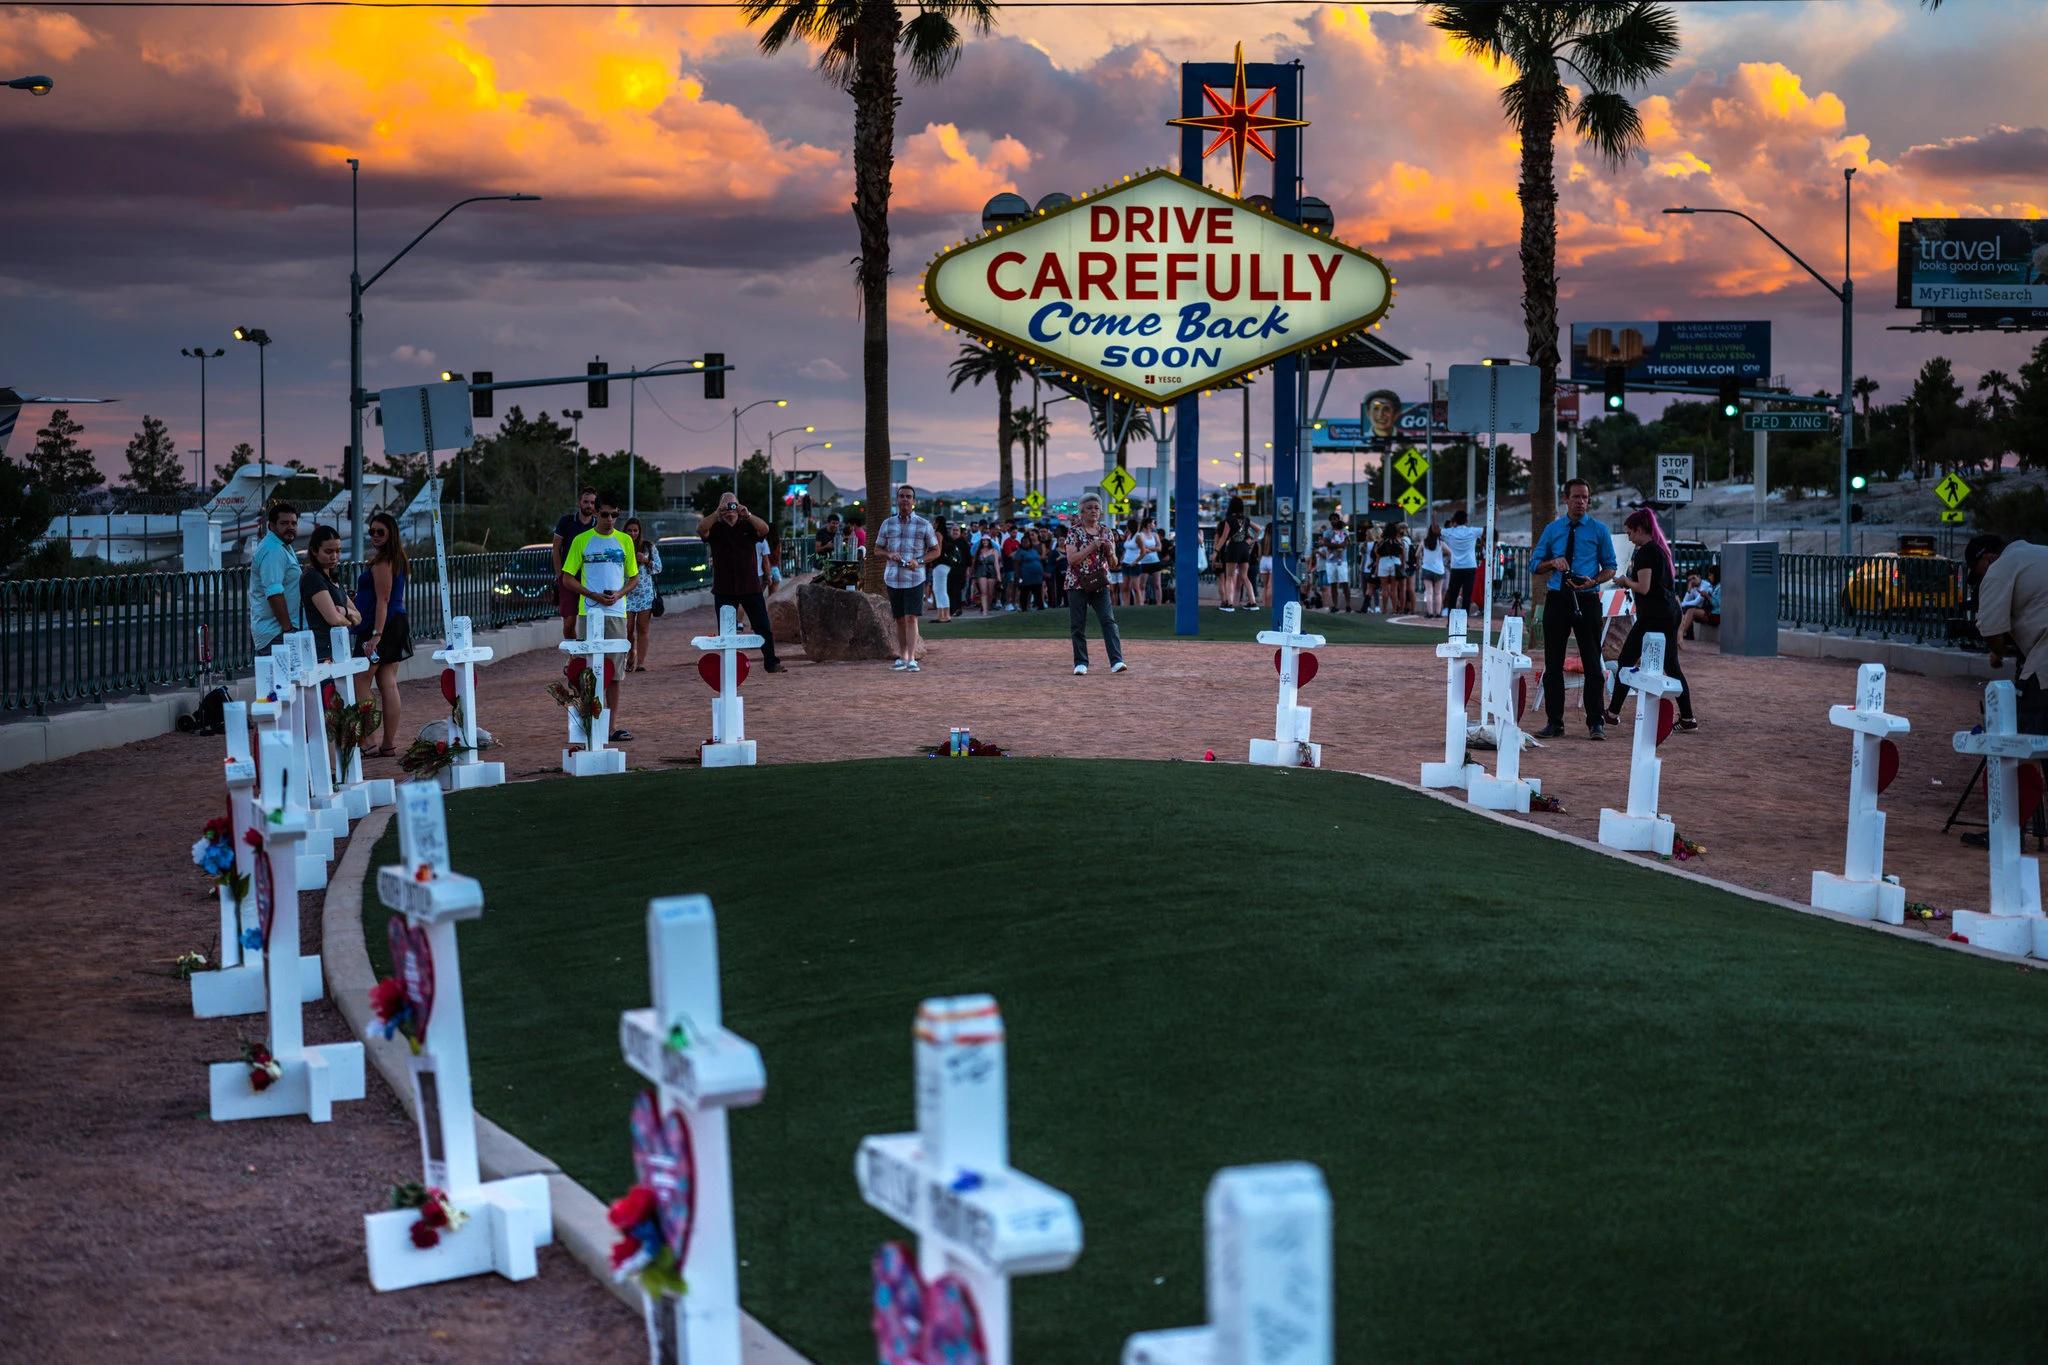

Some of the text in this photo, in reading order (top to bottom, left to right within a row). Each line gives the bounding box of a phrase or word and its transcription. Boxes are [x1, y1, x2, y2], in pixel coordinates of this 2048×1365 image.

[1090, 206, 1234, 244] DRIVE
[1919, 235, 2001, 261] travel
[1919, 261, 2020, 274] looks good on you.
[986, 251, 1343, 302] CAREFULLY
[1919, 287, 2033, 303] MyFlightSearch
[1028, 302, 1290, 343] Come Back
[1670, 344, 1746, 352] HIGH-RISE LIVING
[1100, 346, 1222, 369] SOON
[1660, 352, 1685, 360] FROM
[1688, 352, 1705, 360] THE
[1707, 352, 1728, 360] LOW
[1647, 364, 1761, 375] THEONELV.COM one
[1158, 376, 1182, 384] YESCO
[1752, 416, 1822, 429] PED XING
[1661, 458, 1689, 468] STOP
[1659, 489, 1679, 499] RED
